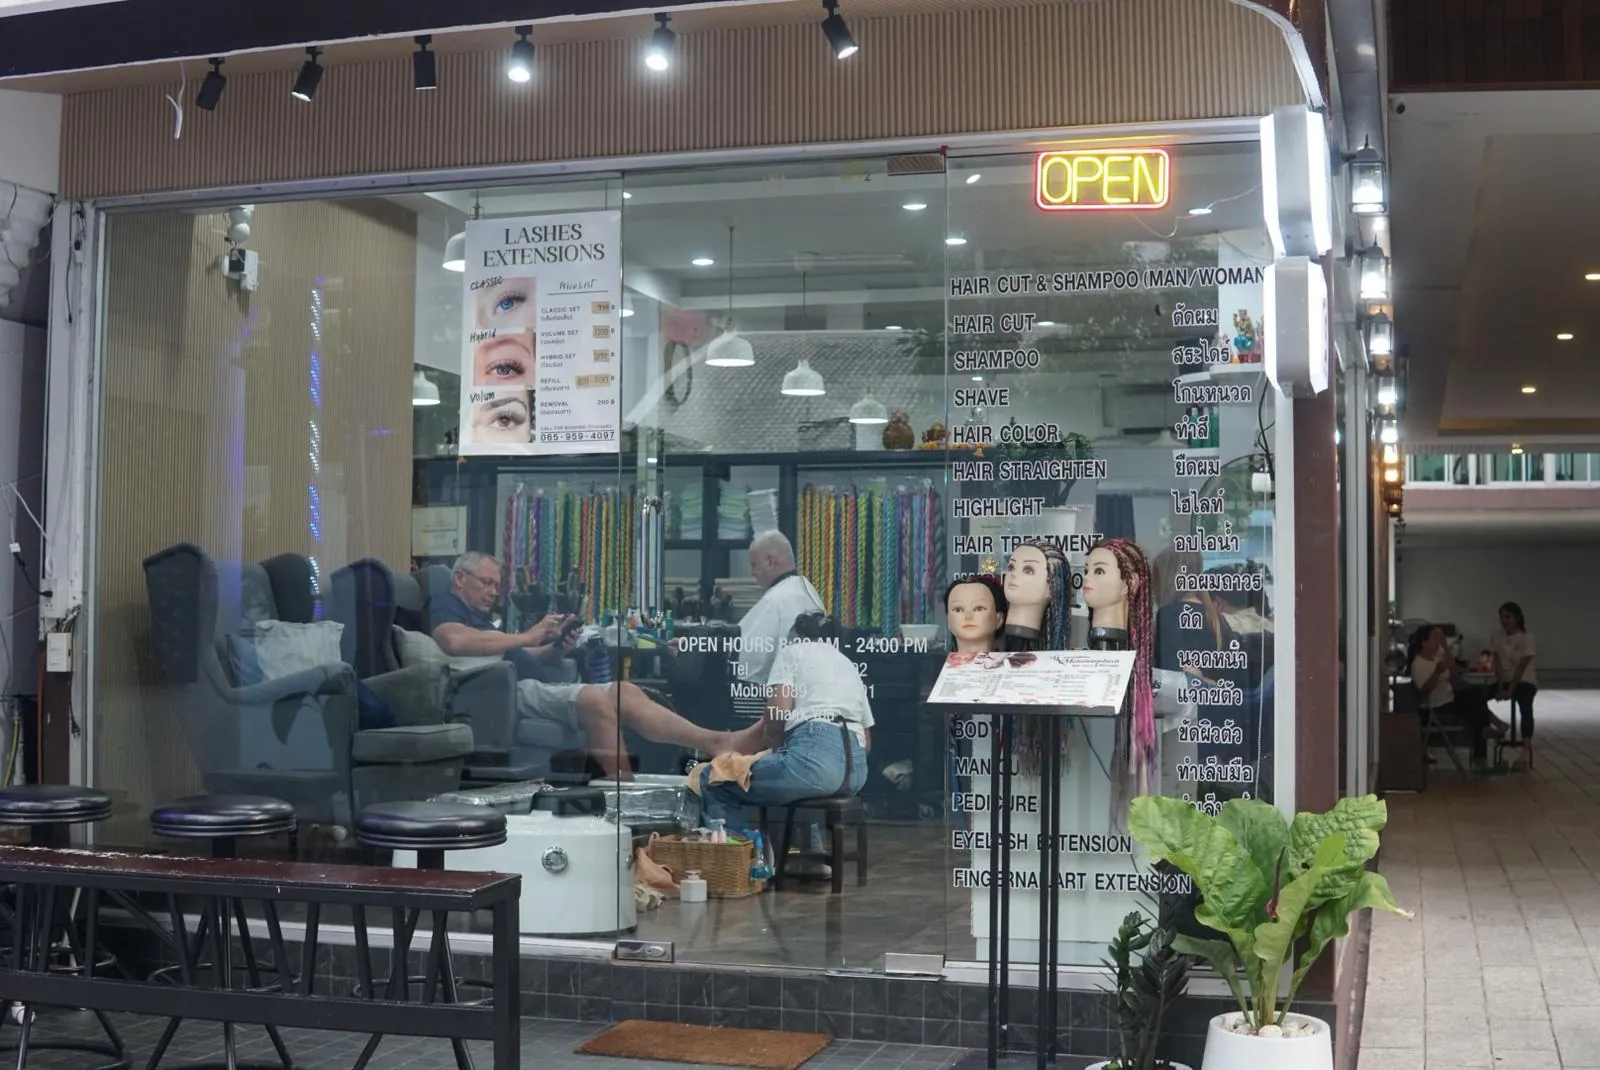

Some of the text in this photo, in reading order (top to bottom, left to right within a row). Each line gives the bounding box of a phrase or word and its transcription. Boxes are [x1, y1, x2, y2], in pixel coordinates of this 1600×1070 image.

[1041, 155, 1164, 203] OPEN
[504, 223, 582, 245] LASHES
[483, 243, 605, 267] EXTENSIONS
[470, 276, 503, 291] CLASSIC
[951, 277, 990, 296] HAIR
[997, 275, 1031, 294] CUT
[1036, 274, 1047, 292] &
[1052, 270, 1138, 292] SHAMPOO
[541, 306, 568, 314] CLASSIC
[1172, 302, 1218, 326] ตัดผม
[953, 313, 1035, 334] HAIR CUT
[469, 328, 497, 344] Hybrid
[954, 350, 1039, 370] SHAMPOO
[1172, 337, 1230, 364] สระไดร์
[954, 389, 1009, 407] SHAVE
[1172, 378, 1252, 403] โกนหนวด
[540, 431, 615, 441] 065-959-4097
[953, 423, 1059, 444] HAIR COLOR
[1175, 415, 1208, 439] ทำสี
[953, 460, 1107, 481] HAIR STRAIGHTEN
[1175, 453, 1221, 476] ยืดผม
[953, 497, 1044, 517] HIGHLIGHT
[1171, 487, 1224, 514] ไฮไลท์
[953, 535, 993, 554] HAIR
[1174, 520, 1239, 552] อบไอน้ำ
[1175, 565, 1263, 591] ต่อผมถาวร
[1179, 604, 1202, 629] ดัด
[678, 637, 718, 653] OPEN
[723, 637, 774, 653] HOURS
[856, 637, 899, 653] 24:00
[904, 638, 928, 654] PM
[1177, 640, 1247, 669] นวดหน้า
[730, 661, 749, 677] Tel
[730, 684, 778, 698] Mobile:
[1178, 719, 1243, 744] ขัดผิวตัว
[1176, 756, 1253, 782] ทำเล็บมือ
[1037, 832, 1132, 854] ETENSION
[1094, 873, 1192, 894] EXTENSION
